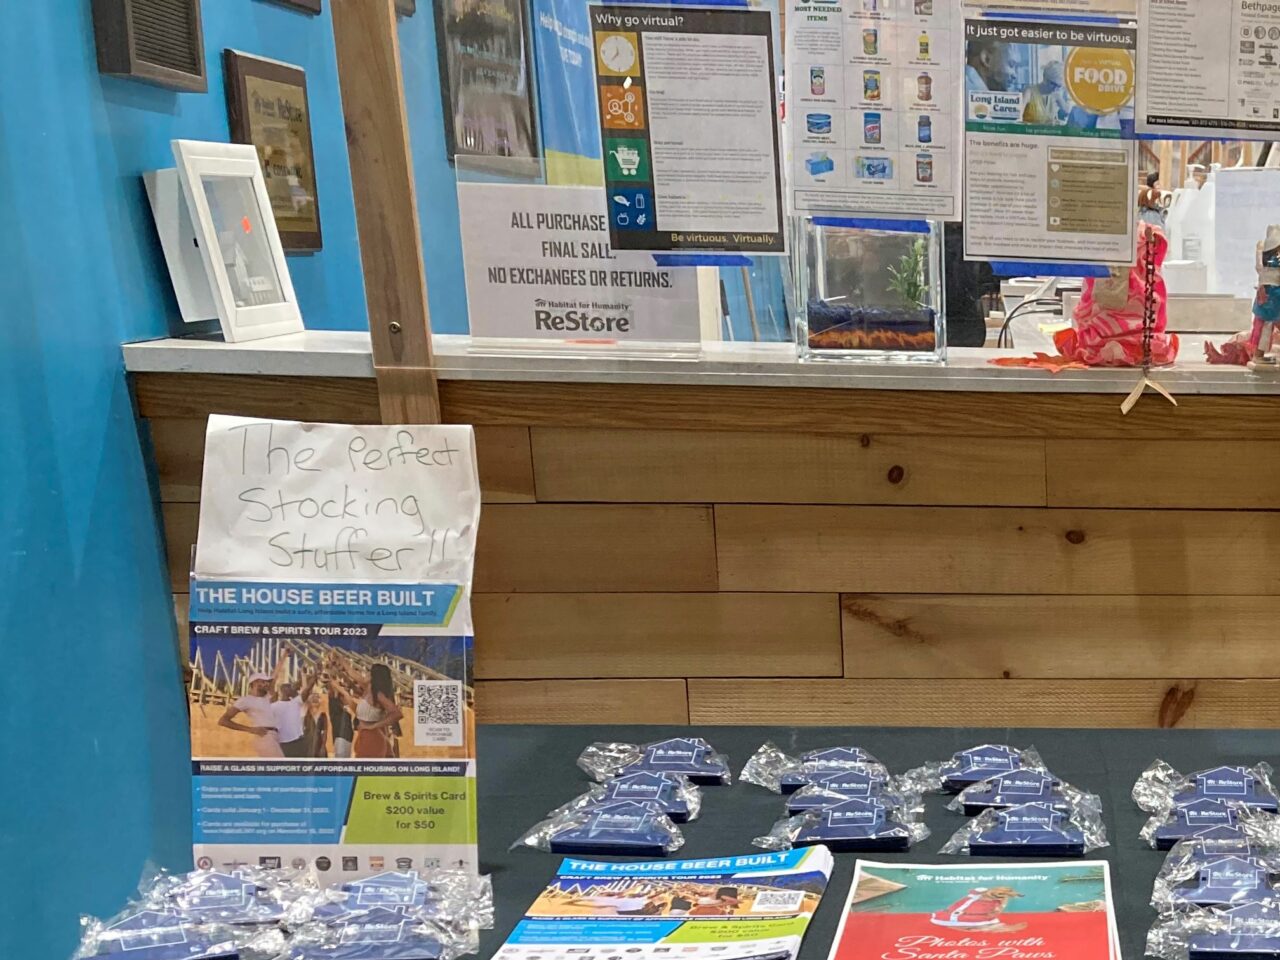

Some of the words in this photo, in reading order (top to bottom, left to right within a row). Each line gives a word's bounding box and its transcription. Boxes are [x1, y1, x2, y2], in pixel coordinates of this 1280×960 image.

[595, 14, 622, 27] Why
[624, 16, 639, 27] go
[642, 16, 684, 27] virtual?
[966, 25, 975, 34] It
[976, 26, 997, 37] just
[1000, 27, 1018, 39] got
[1021, 29, 1053, 38] easier
[1056, 31, 1067, 39] to
[1070, 31, 1084, 41] be
[1087, 33, 1133, 44] virtuous.
[1074, 68, 1127, 85] FOOD
[970, 95, 992, 104] Long
[994, 96, 1020, 104] Island
[511, 212, 534, 229] ALL
[671, 234, 684, 242] Be
[686, 234, 729, 243] virtuous.
[733, 234, 776, 245] Virtually.
[541, 241, 578, 258] FINAL
[488, 267, 506, 284] NO
[510, 268, 586, 286] EXCHANGES
[590, 270, 607, 287] OR
[610, 271, 673, 288] RETURNS.
[548, 301, 577, 309] Habitat
[579, 302, 590, 310] for
[591, 302, 629, 311] Humanity
[535, 310, 630, 333] ReStore
[228, 422, 322, 476] The
[348, 430, 460, 473] Perfect
[238, 483, 425, 537] Stocking
[268, 526, 415, 571] Stuffer
[195, 587, 237, 604] THE
[241, 588, 314, 605] HOUSE
[319, 589, 373, 606] BEER
[378, 590, 435, 606] BUILT
[194, 625, 228, 634] CRAFT
[230, 625, 261, 634] BREW
[263, 626, 270, 635] &
[272, 626, 311, 635] SPIRITS
[313, 626, 341, 635] TOUR
[342, 627, 367, 636] 2023
[200, 764, 222, 772] RAISE
[223, 764, 229, 772] A
[230, 764, 256, 772] GLASS
[265, 765, 300, 773] SUPPORT
[301, 765, 312, 773] OF
[313, 765, 362, 773] AFFORDABLE
[363, 765, 396, 773] HOUSING
[397, 765, 408, 773] ON
[410, 765, 430, 773] LONG
[431, 765, 460, 773] ISLAND!
[364, 791, 392, 800] Brew
[395, 791, 401, 800] &
[404, 791, 439, 802] Spirits
[441, 791, 466, 801] Card
[385, 805, 413, 816] $200
[416, 806, 444, 815] value
[396, 819, 411, 830] for
[413, 819, 435, 831] $50
[569, 860, 610, 872] THE
[613, 859, 681, 871] HOUSE
[682, 857, 737, 869] BEER
[739, 853, 790, 867] BUILT
[894, 935, 991, 949] Photos
[998, 936, 1046, 948] with
[881, 947, 969, 960] Santa
[979, 947, 1056, 960] Paws
